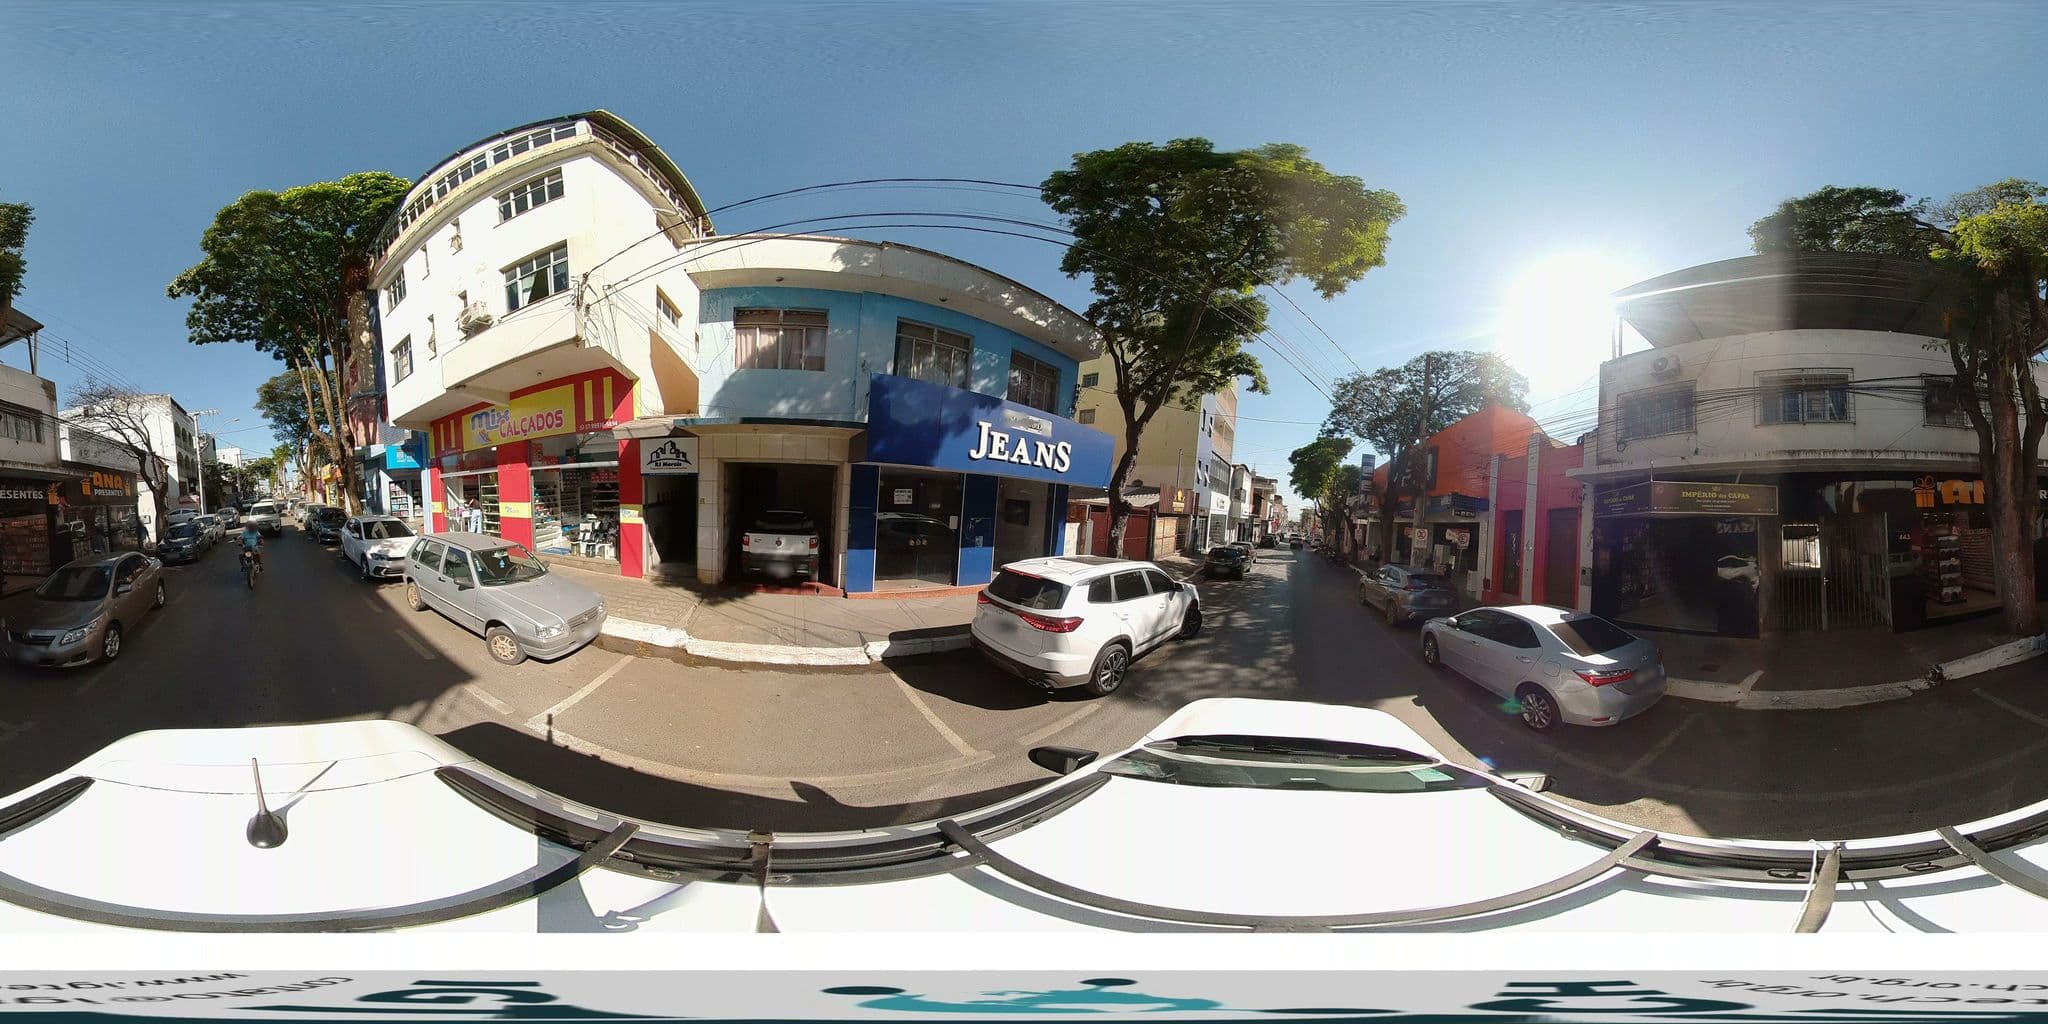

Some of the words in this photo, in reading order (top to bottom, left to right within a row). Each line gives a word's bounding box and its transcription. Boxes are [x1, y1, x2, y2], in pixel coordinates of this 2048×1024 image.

[499, 409, 564, 440] CALÇADOS
[969, 421, 1072, 473] JEANS
[93, 471, 123, 489] ANA
[94, 488, 124, 497] PRESENTES
